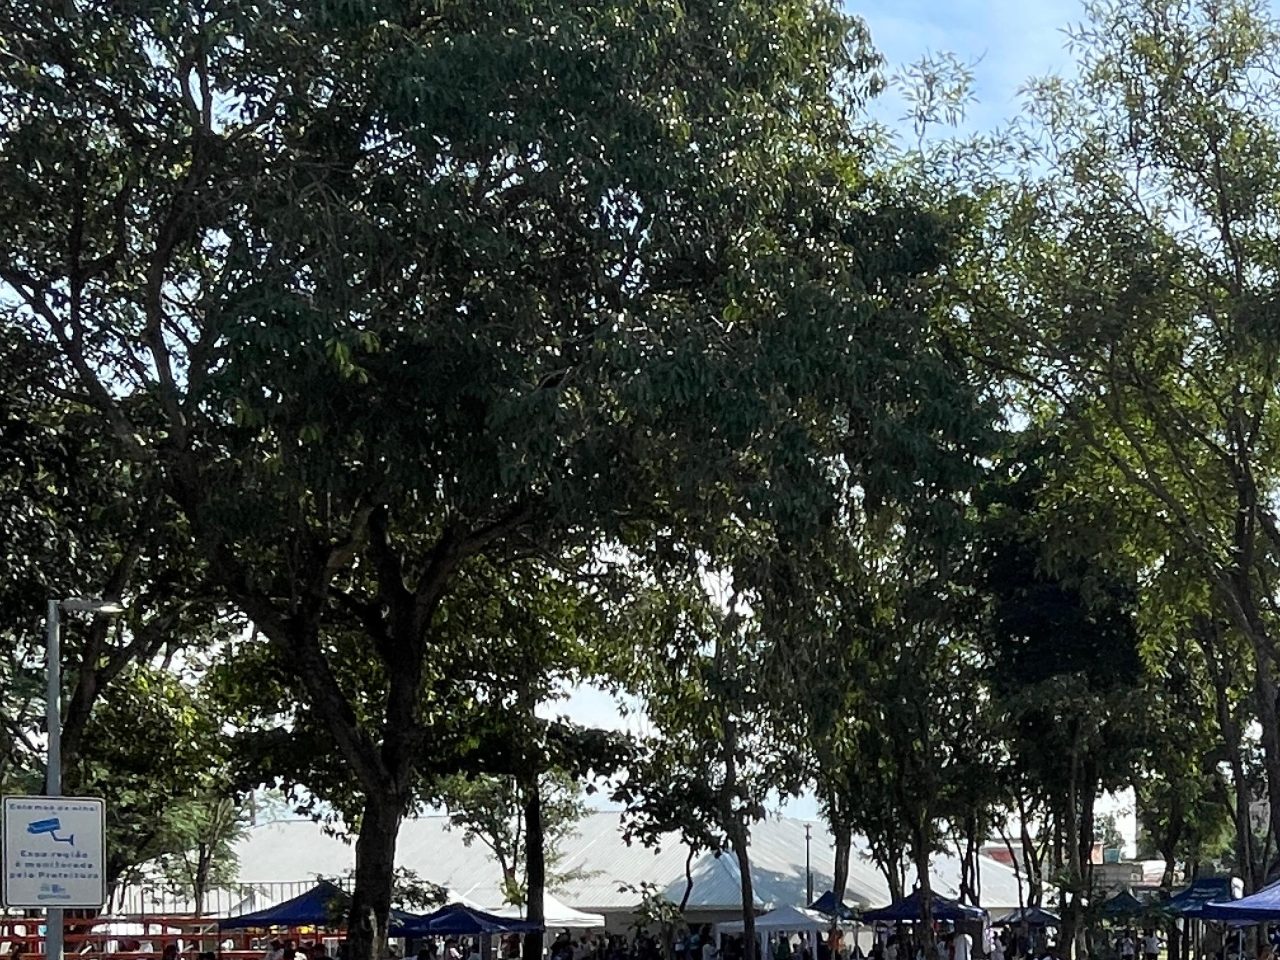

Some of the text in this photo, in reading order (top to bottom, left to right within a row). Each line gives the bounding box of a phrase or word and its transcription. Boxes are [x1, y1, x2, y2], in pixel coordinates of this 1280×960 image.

[20, 850, 88, 859] Essa região
[25, 861, 93, 869] monitorada
[38, 871, 99, 879] Prefeitura
